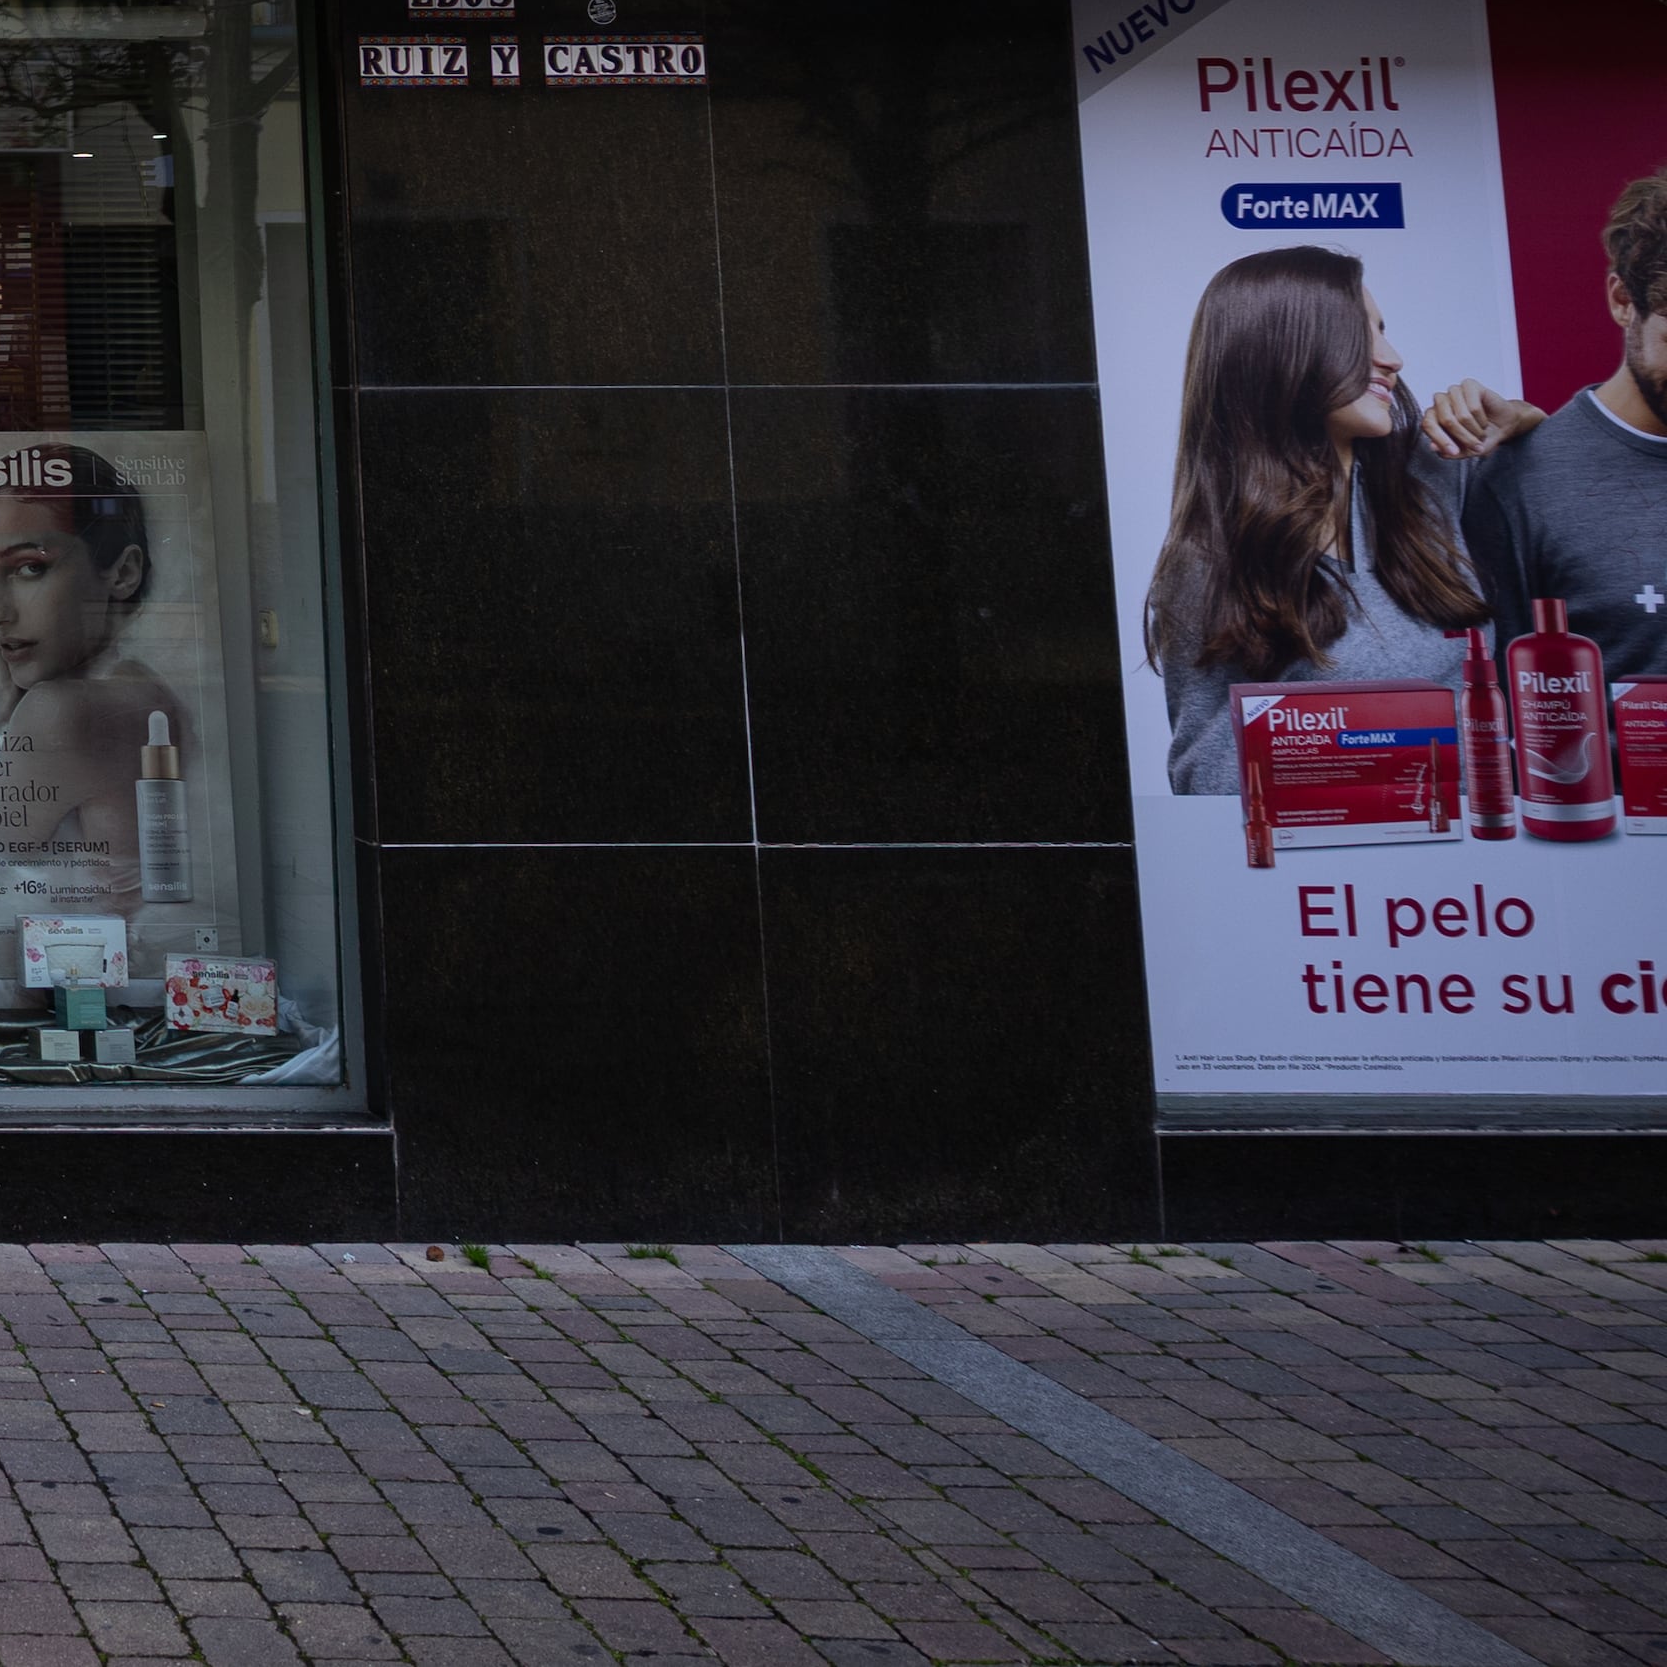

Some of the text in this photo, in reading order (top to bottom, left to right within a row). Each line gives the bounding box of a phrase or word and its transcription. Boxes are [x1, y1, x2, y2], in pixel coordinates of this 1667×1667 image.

[362, 45, 705, 75] RUIZ Y CASTRO
[1205, 121, 1414, 159] ANTICAÍDA
[115, 454, 186, 471] Sensitive
[116, 471, 186, 487] Skin Lab
[1518, 671, 1591, 695] Pilexil
[1521, 699, 1572, 710] CHAMPÚ
[1268, 706, 1348, 733] Pilexil
[1522, 710, 1589, 722] ANTICAÍDA
[1271, 733, 1333, 747] ANTICAÍDA
[1271, 747, 1319, 756] AMPOLLAS
[9, 841, 50, 853] EGF-5
[52, 841, 110, 855] [SERUM]
[8, 859, 62, 867] crecimiento
[71, 859, 111, 868] péptidos
[13, 880, 47, 895] +16%
[50, 885, 112, 895] Luminosidad
[50, 895, 58, 903] al
[1297, 884, 1536, 948] El pelo
[1302, 960, 1667, 1014] tiene su ci
